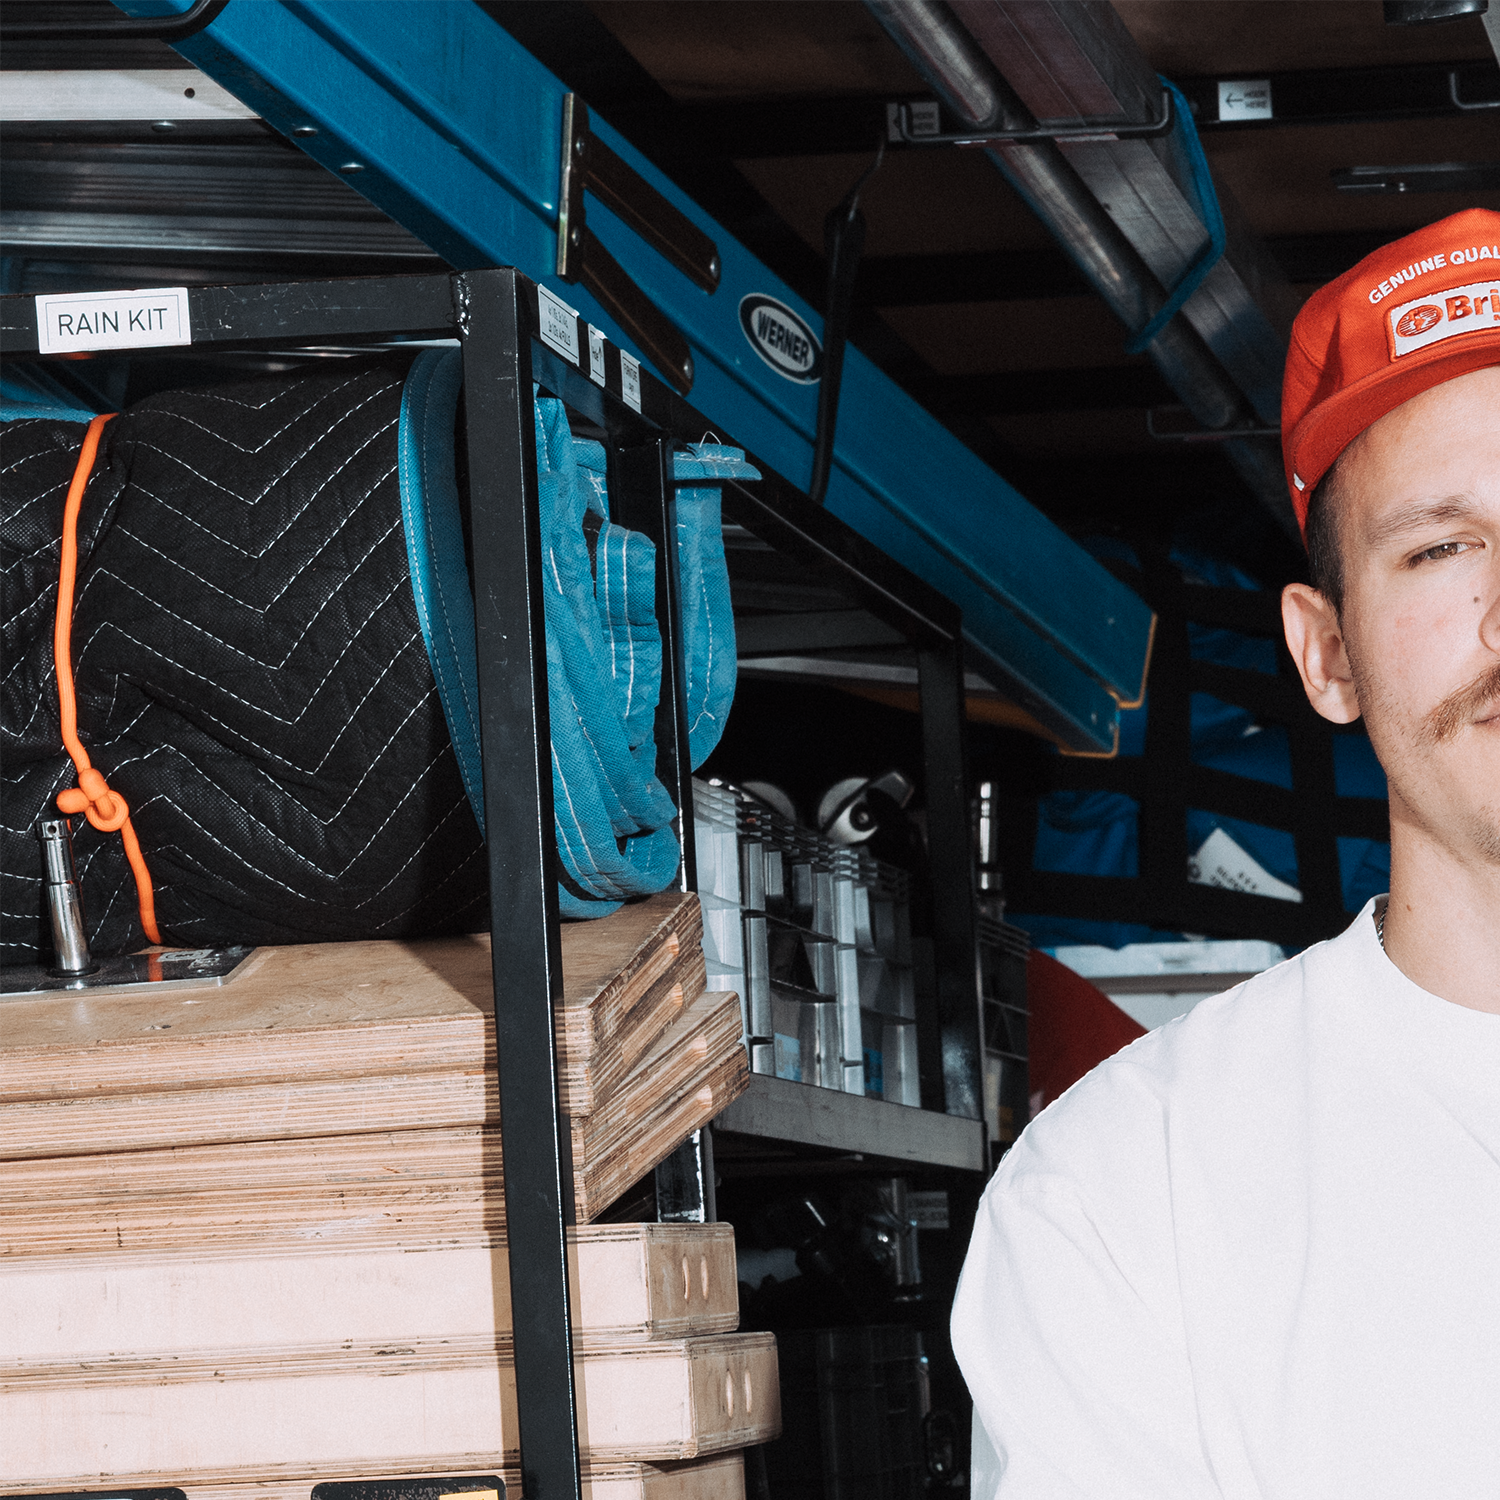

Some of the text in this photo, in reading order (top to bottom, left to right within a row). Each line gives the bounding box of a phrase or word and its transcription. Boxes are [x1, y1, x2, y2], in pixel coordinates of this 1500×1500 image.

[1368, 253, 1448, 304] GENUINE
[58, 308, 167, 336] RAIN KIT
[758, 310, 810, 368] WERNER
